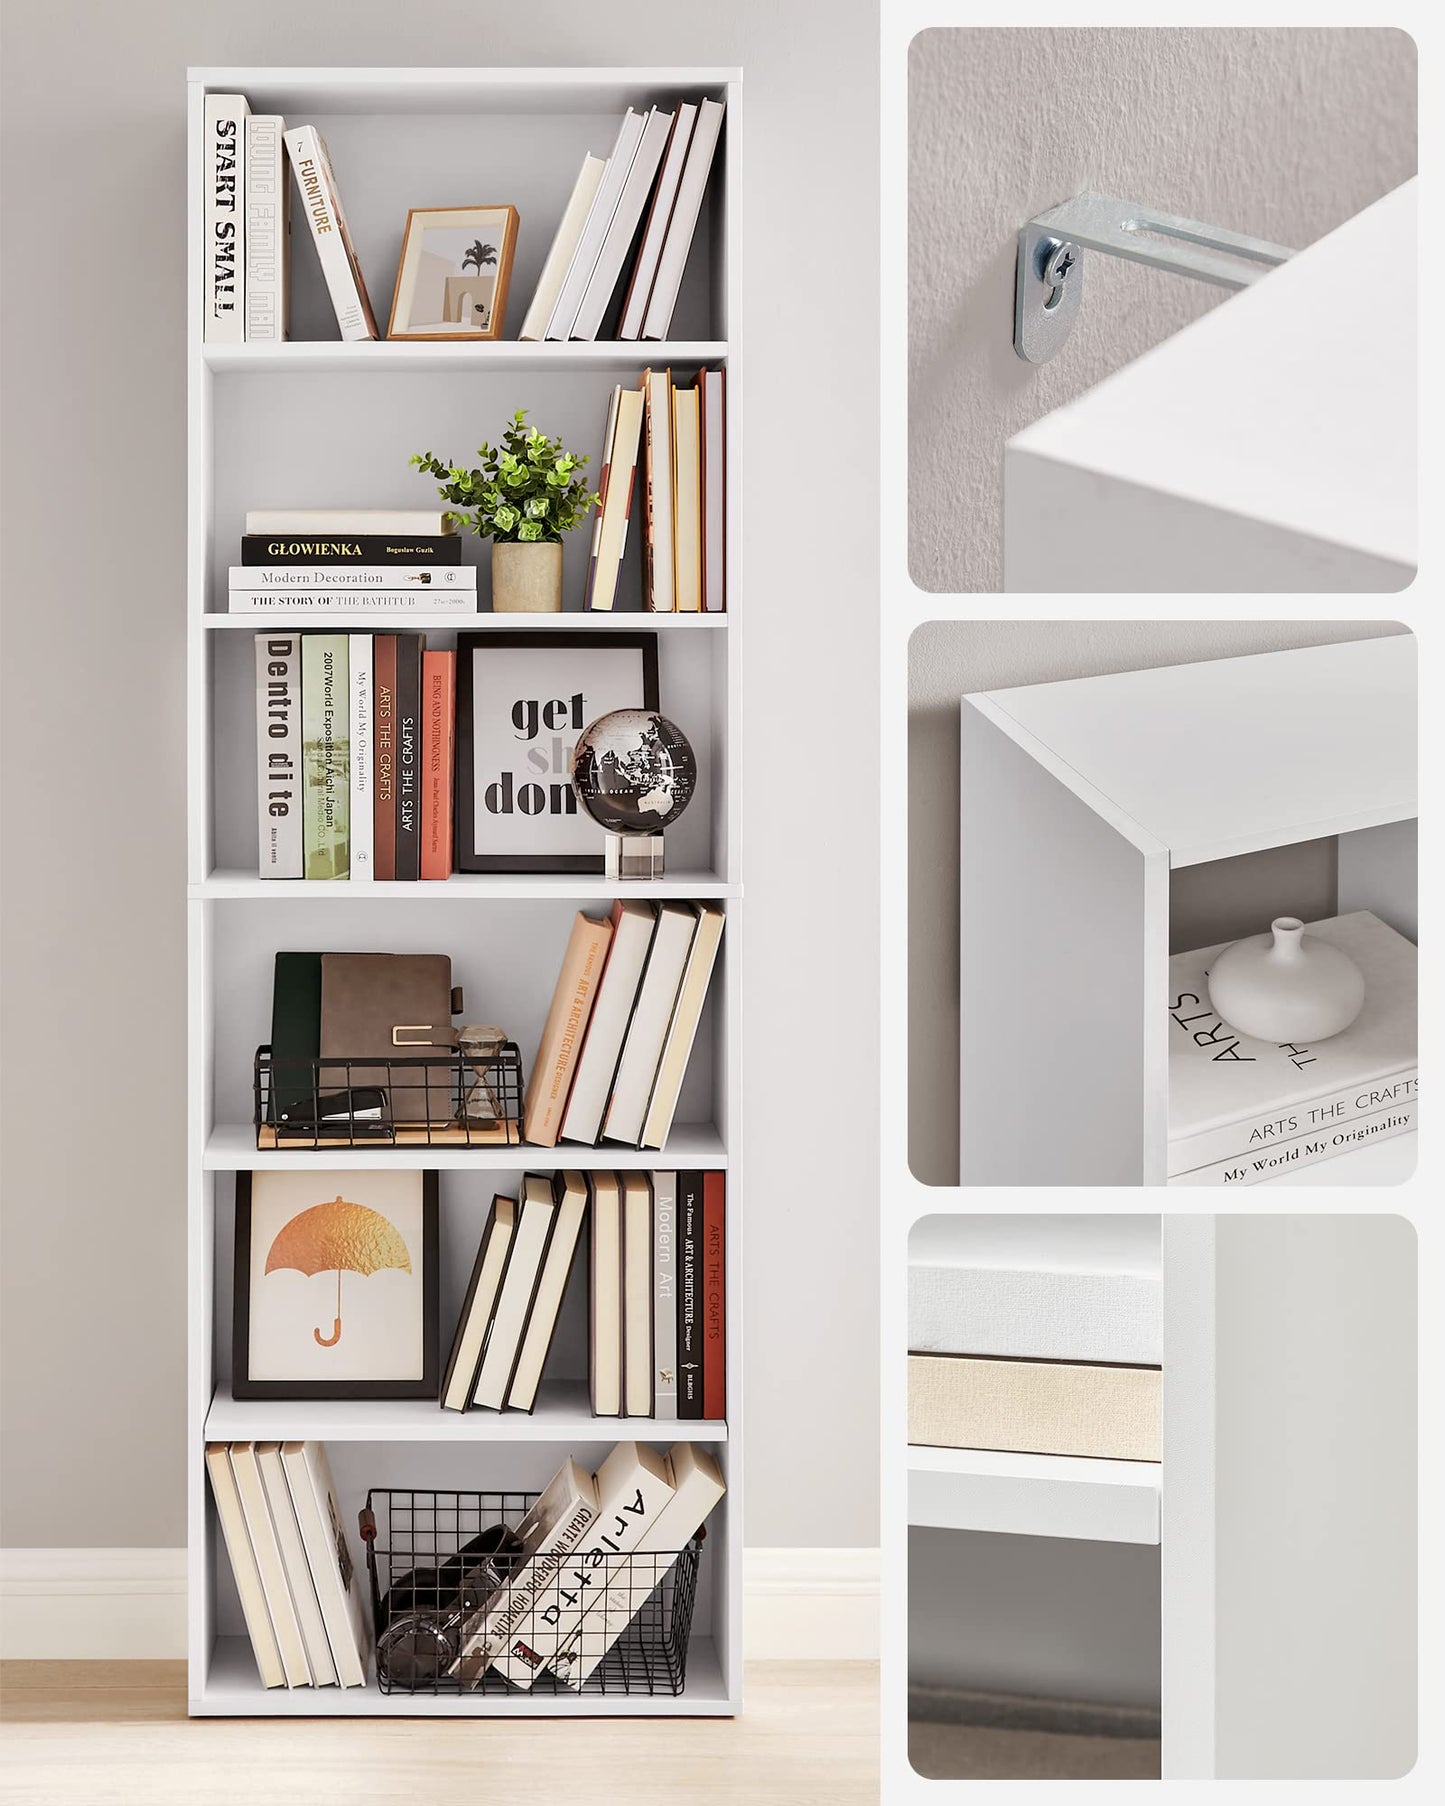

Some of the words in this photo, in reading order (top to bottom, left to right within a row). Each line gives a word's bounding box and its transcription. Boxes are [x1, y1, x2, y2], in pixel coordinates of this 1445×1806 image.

[215, 119, 237, 213] START
[299, 159, 332, 235] FURNITURE
[214, 221, 236, 319] SMALL
[268, 543, 363, 556] GŁOWIENKA
[415, 546, 434, 554] Guzik
[261, 572, 310, 583] Modern
[314, 572, 384, 583] Decoration
[251, 597, 276, 606] THE
[278, 597, 314, 606] STORY
[318, 597, 334, 606] OF
[336, 597, 360, 606] THE
[362, 597, 416, 606] BATHTUB
[267, 640, 292, 738] Dentro
[323, 651, 333, 707] 2007World
[356, 672, 366, 687] My
[432, 675, 442, 700] BEING
[358, 689, 367, 719] World
[379, 686, 391, 718] ARTS
[432, 700, 441, 717] AND
[511, 693, 587, 740] get
[322, 710, 334, 765] Exposition
[357, 722, 367, 737] My
[380, 722, 391, 748] THE
[402, 717, 413, 764] CRAFTS
[431, 717, 441, 773] NOTHINGNESS
[269, 753, 293, 780] di
[357, 739, 368, 792] Originality
[527, 737, 573, 775] sh
[324, 767, 335, 793] Aichi
[380, 753, 391, 800] CRAFTS
[402, 769, 413, 794] THE
[269, 791, 292, 817] te
[485, 772, 577, 815] don
[323, 796, 335, 828] Japan
[402, 800, 413, 831] ARTS
[573, 997, 582, 1005] &
[577, 979, 590, 998] ART
[554, 1005, 583, 1073] ARCHITECTURE
[1169, 993, 1256, 1061] ARTS
[1278, 1043, 1317, 1070] TH
[1249, 1116, 1298, 1143] ARTS
[1307, 1101, 1345, 1124] THE
[1223, 1166, 1247, 1183] My
[1252, 1149, 1300, 1172] World
[1305, 1142, 1328, 1156] My
[1332, 1115, 1411, 1145] Originality
[658, 1197, 672, 1263] Modern
[685, 1238, 693, 1254] ART
[709, 1224, 720, 1256] ARTS
[660, 1272, 673, 1298] Art
[709, 1262, 720, 1287] THE
[684, 1262, 693, 1324] ARCHITECTURE
[708, 1293, 719, 1340] CRAFTS
[562, 1508, 593, 1543] CREATE
[522, 1538, 571, 1596] WONDERFUL
[540, 1488, 646, 1626] Arletta
